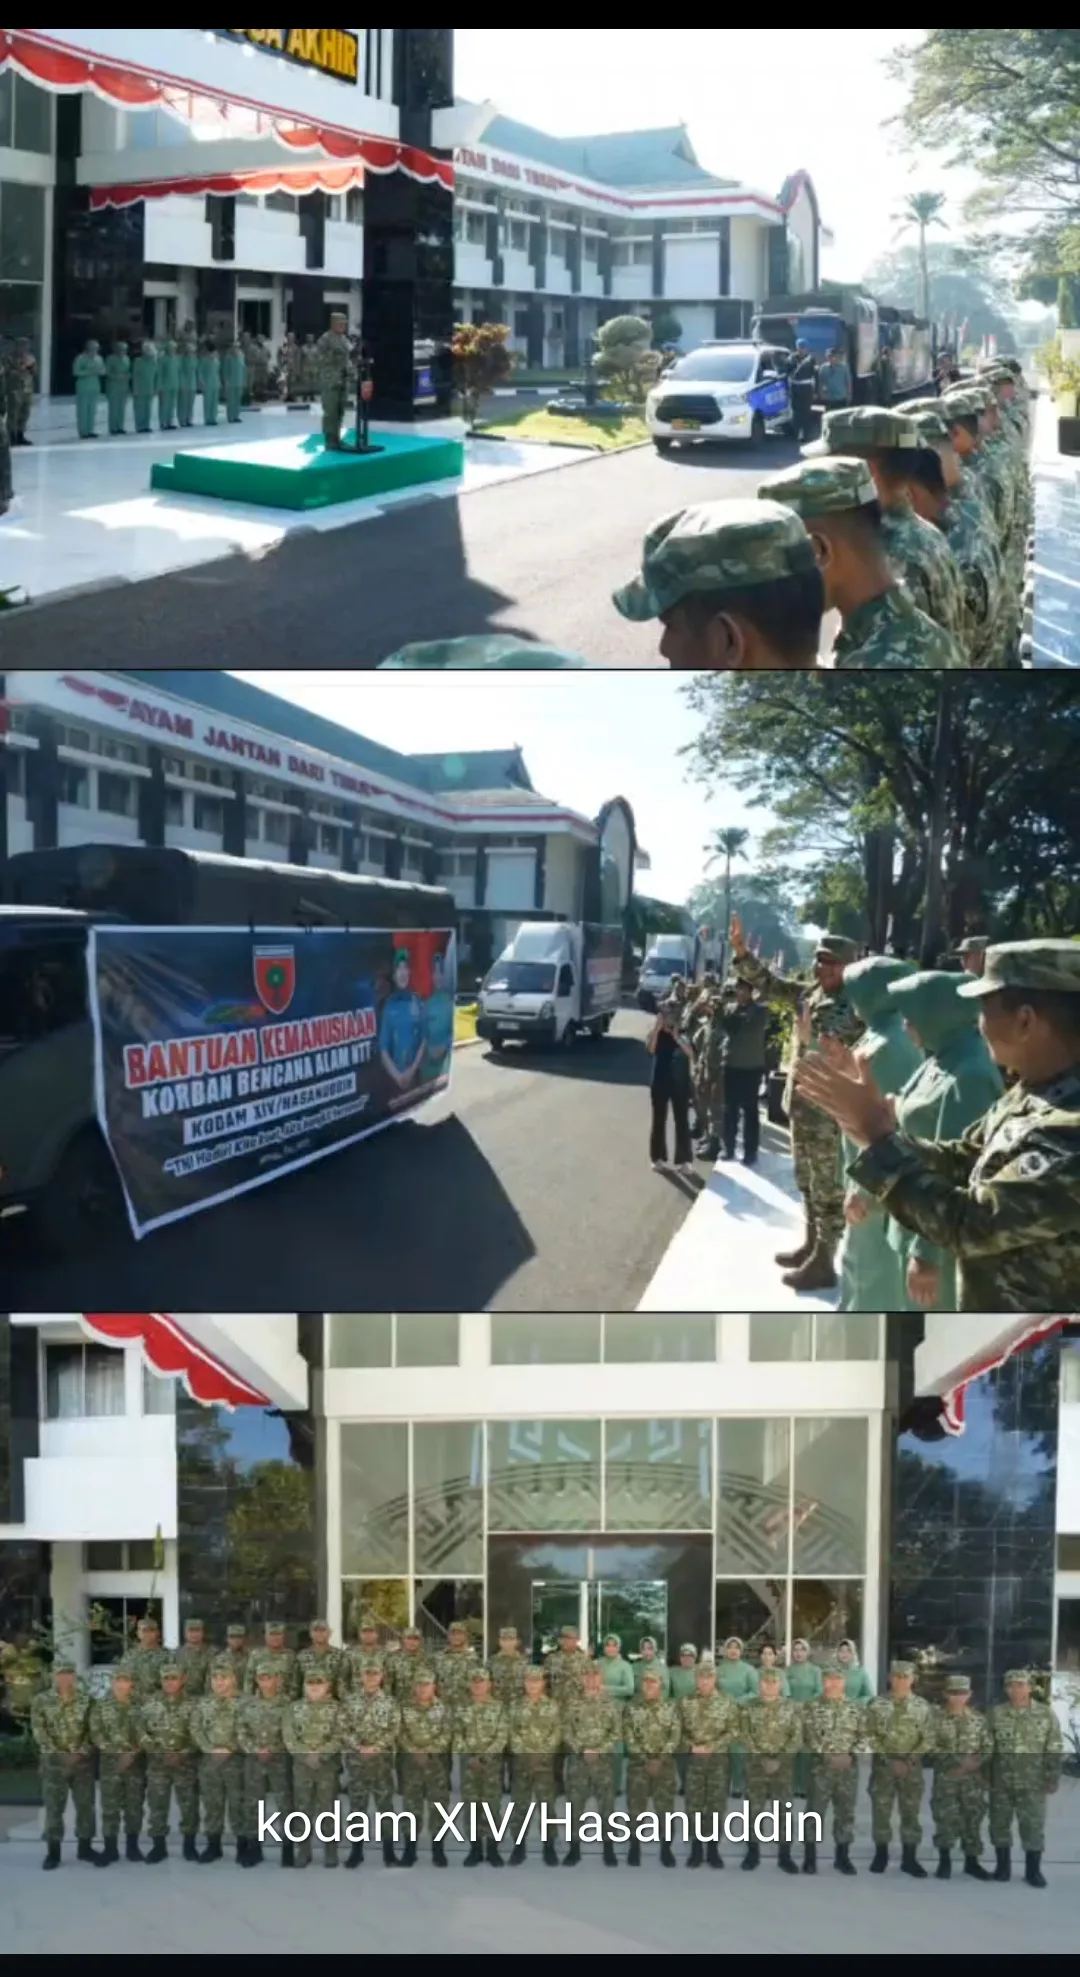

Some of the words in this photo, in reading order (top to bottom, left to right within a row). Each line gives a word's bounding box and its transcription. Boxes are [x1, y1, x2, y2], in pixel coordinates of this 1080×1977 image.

[287, 29, 357, 77] AKHIR
[129, 699, 194, 739] AYAM
[203, 726, 281, 767] JANTAN
[287, 755, 325, 782] DARI
[124, 1029, 258, 1088] BANTUAN
[261, 1008, 375, 1063] KEMANUSIAAN
[141, 1074, 232, 1118] KORBAN
[237, 1055, 314, 1096] BENCANA
[315, 1045, 350, 1076] ALAM
[191, 1108, 247, 1138] KODAM
